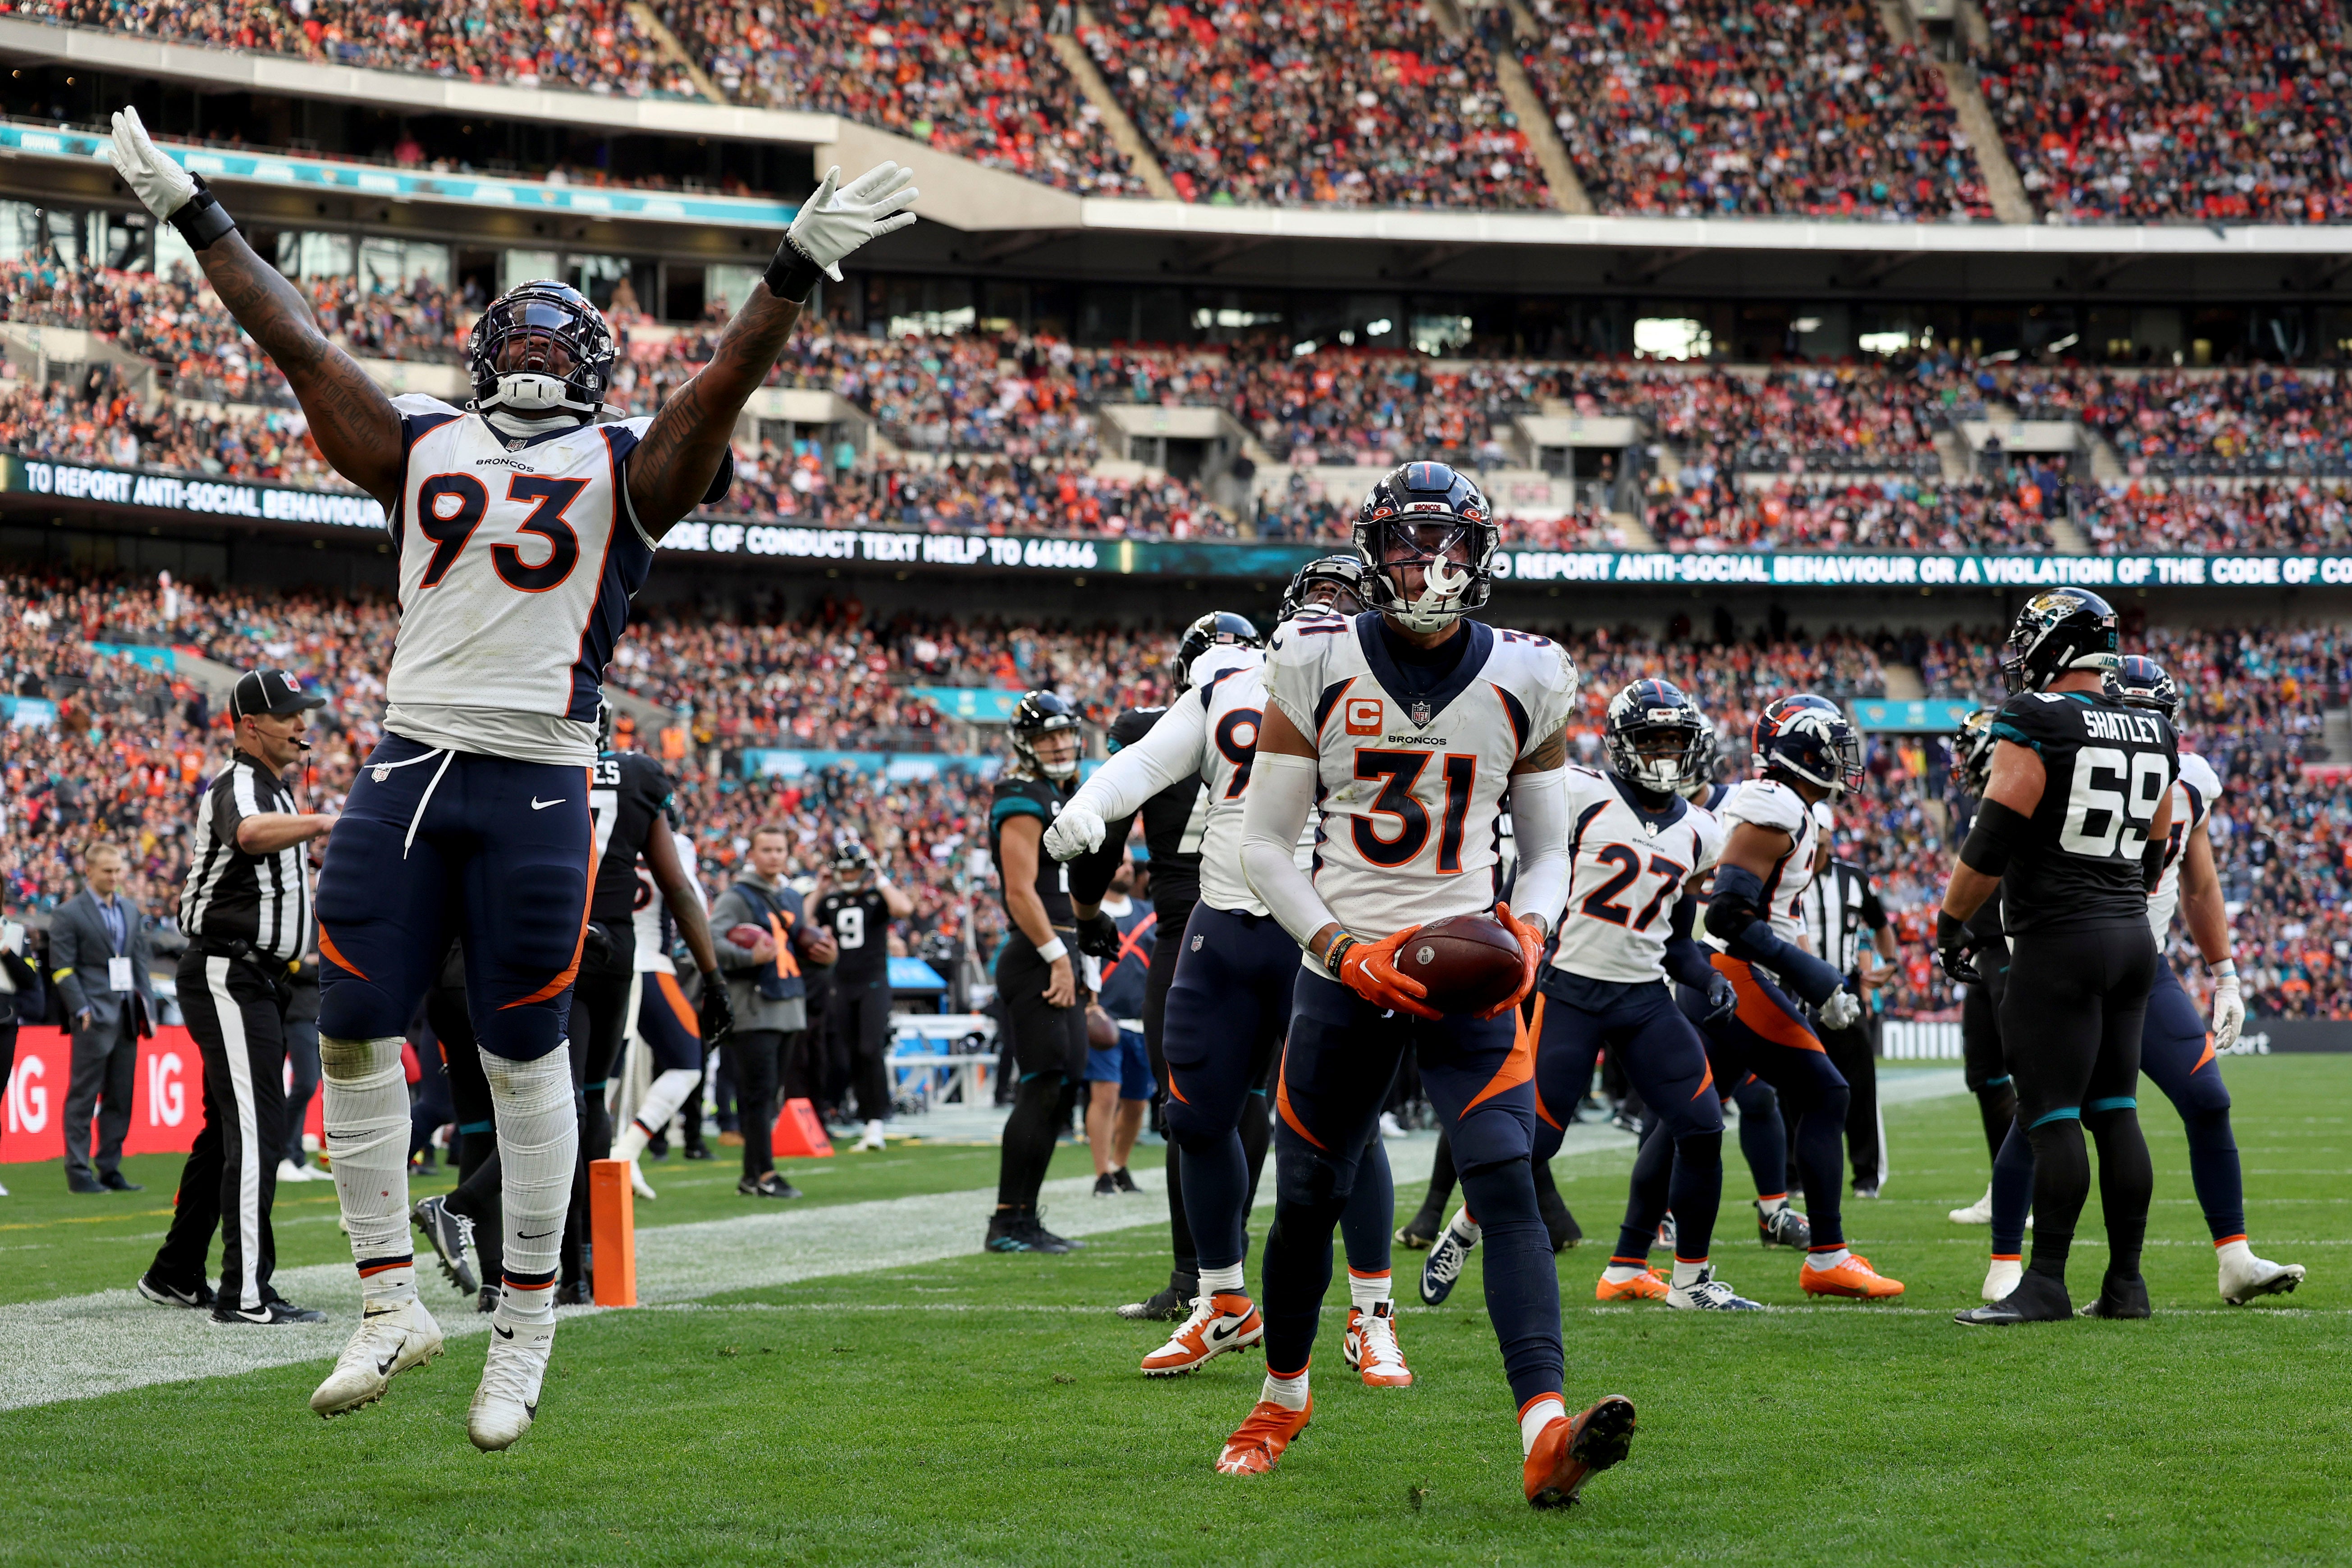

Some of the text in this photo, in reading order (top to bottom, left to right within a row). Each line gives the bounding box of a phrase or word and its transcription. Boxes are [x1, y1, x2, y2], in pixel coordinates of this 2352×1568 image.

[476, 458, 535, 472] BRONCOS
[24, 462, 387, 529] TO REPORT ANTI-SOCIAL BEHAVIOUR
[418, 472, 592, 593] 93
[656, 521, 1098, 569] ODE OF CONDUCT TEXT HELP TO 66566
[1489, 554, 1512, 580] O
[1515, 553, 1613, 580] REPORT
[1615, 554, 1770, 582] ANTI-SOCIAL
[1773, 556, 1917, 583] BEHAVIOUR
[1919, 557, 1956, 584] OR
[1958, 558, 1980, 583] A
[1982, 558, 2114, 584] VIOLATION
[2117, 558, 2152, 584] OF
[2155, 558, 2205, 584] THE
[2211, 558, 2279, 584] CODE
[2283, 558, 2317, 584] OF
[1349, 701, 1380, 726] C
[1414, 712, 1428, 721] NFL
[2082, 709, 2162, 744] SHATLEY
[1215, 708, 1263, 799] 9
[1388, 735, 1447, 745] BRONCOS
[592, 760, 621, 785] ES
[1350, 747, 1477, 874] 31
[2059, 746, 2170, 860] 69
[1632, 838, 1665, 852] BRONCOS
[1579, 842, 1688, 933] 27
[836, 906, 865, 950] 9
[7, 1052, 185, 1133] IG IG
